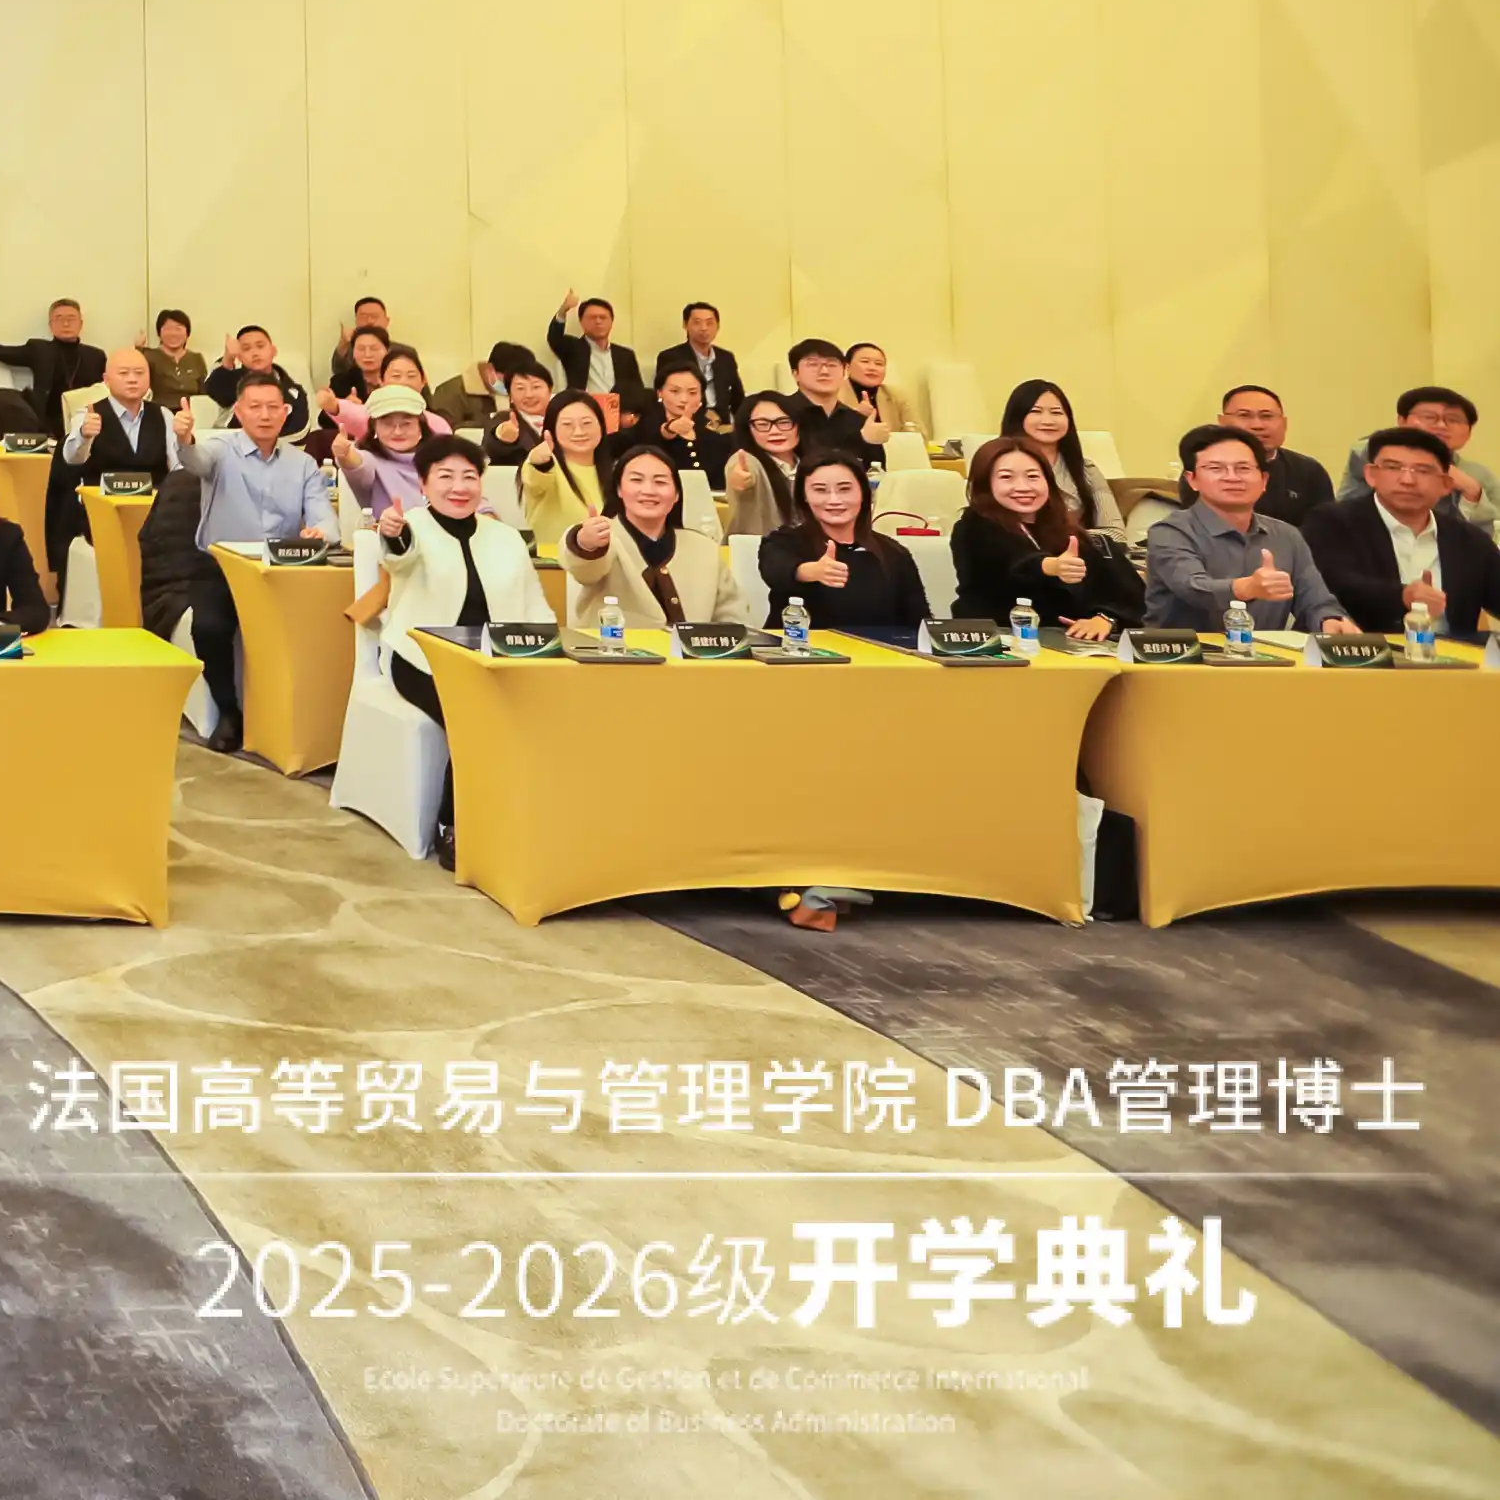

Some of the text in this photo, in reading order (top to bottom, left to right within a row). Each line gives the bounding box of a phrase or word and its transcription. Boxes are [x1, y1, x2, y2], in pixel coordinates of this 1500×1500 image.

[525, 635, 546, 647] 博士
[720, 637, 739, 648] 博士
[970, 632, 990, 644] 博士
